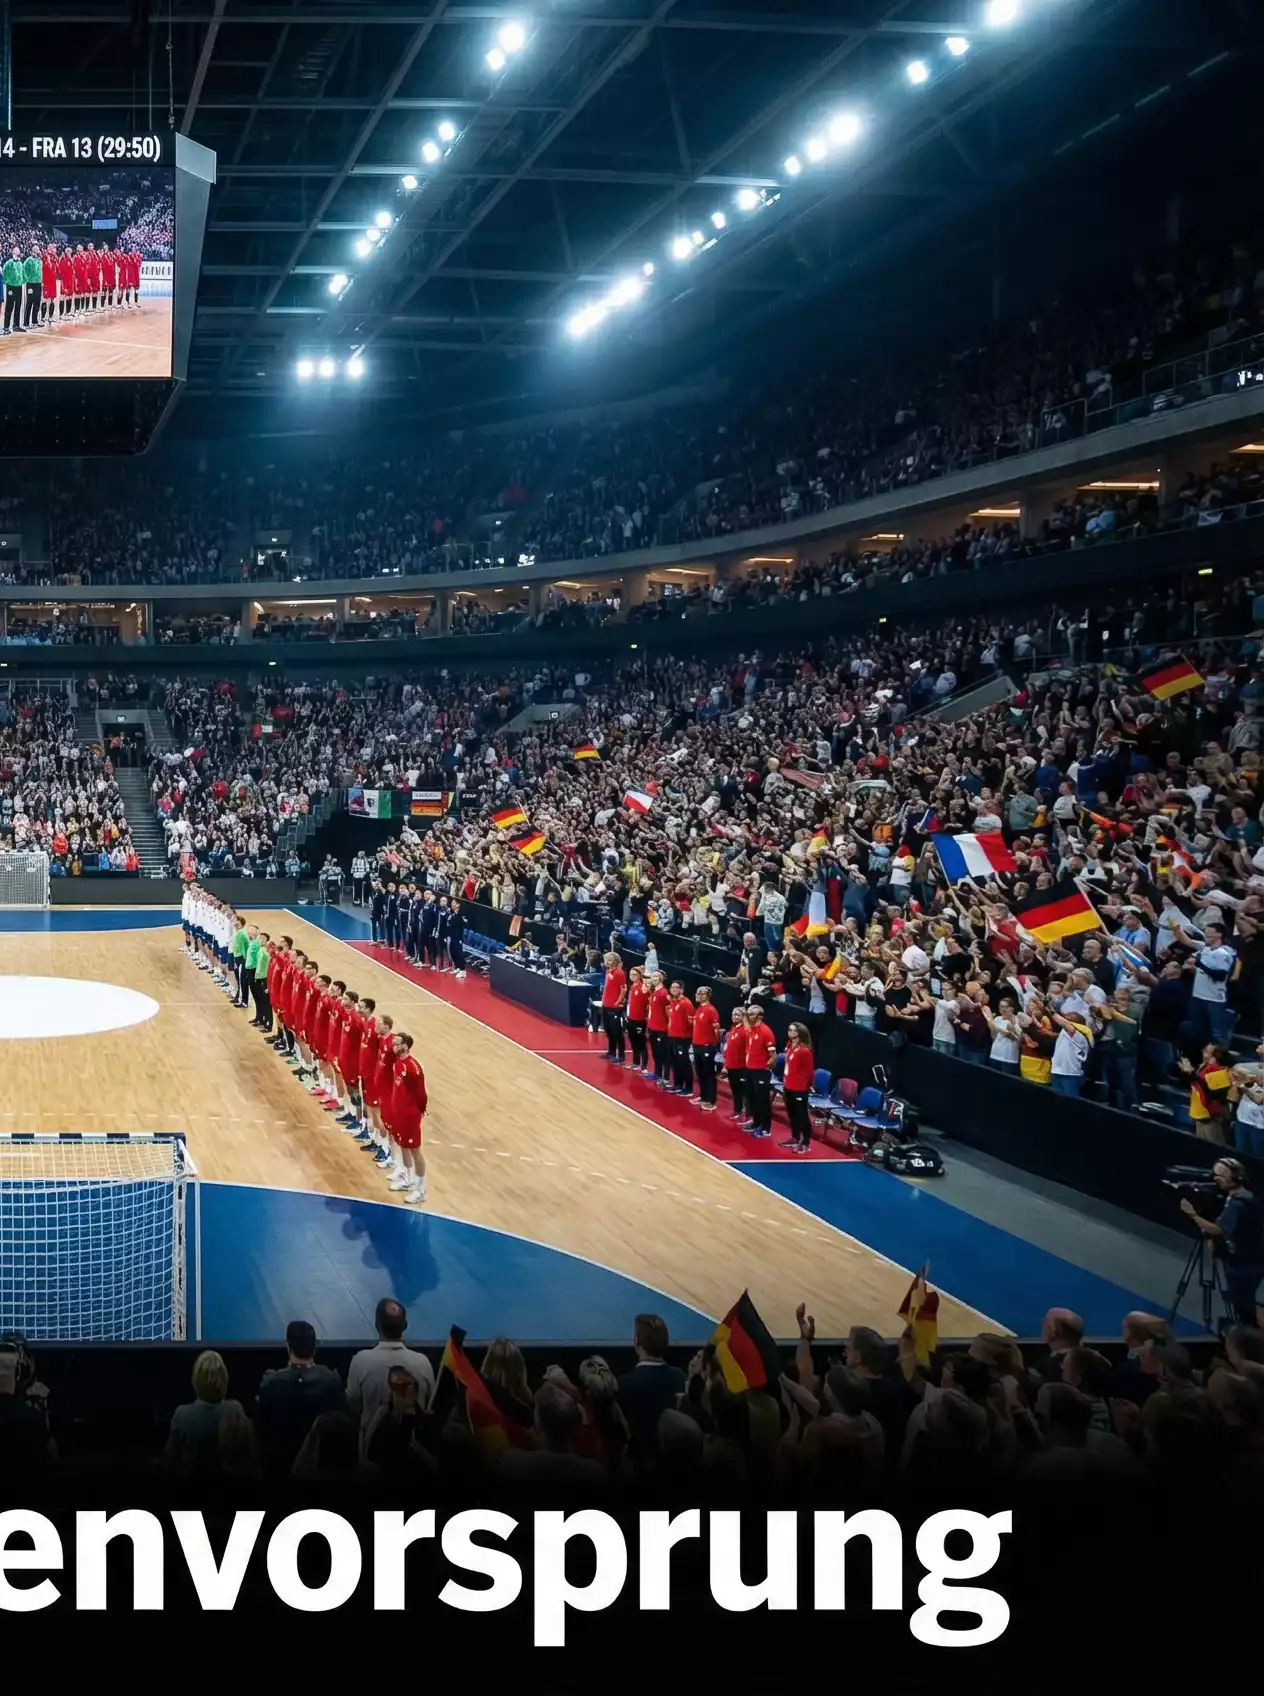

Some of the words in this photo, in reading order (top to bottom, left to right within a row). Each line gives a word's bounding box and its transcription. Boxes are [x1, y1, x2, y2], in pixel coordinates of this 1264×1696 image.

[32, 136, 68, 159] FRA
[71, 136, 93, 159] 13
[97, 135, 161, 163] (29:50)
